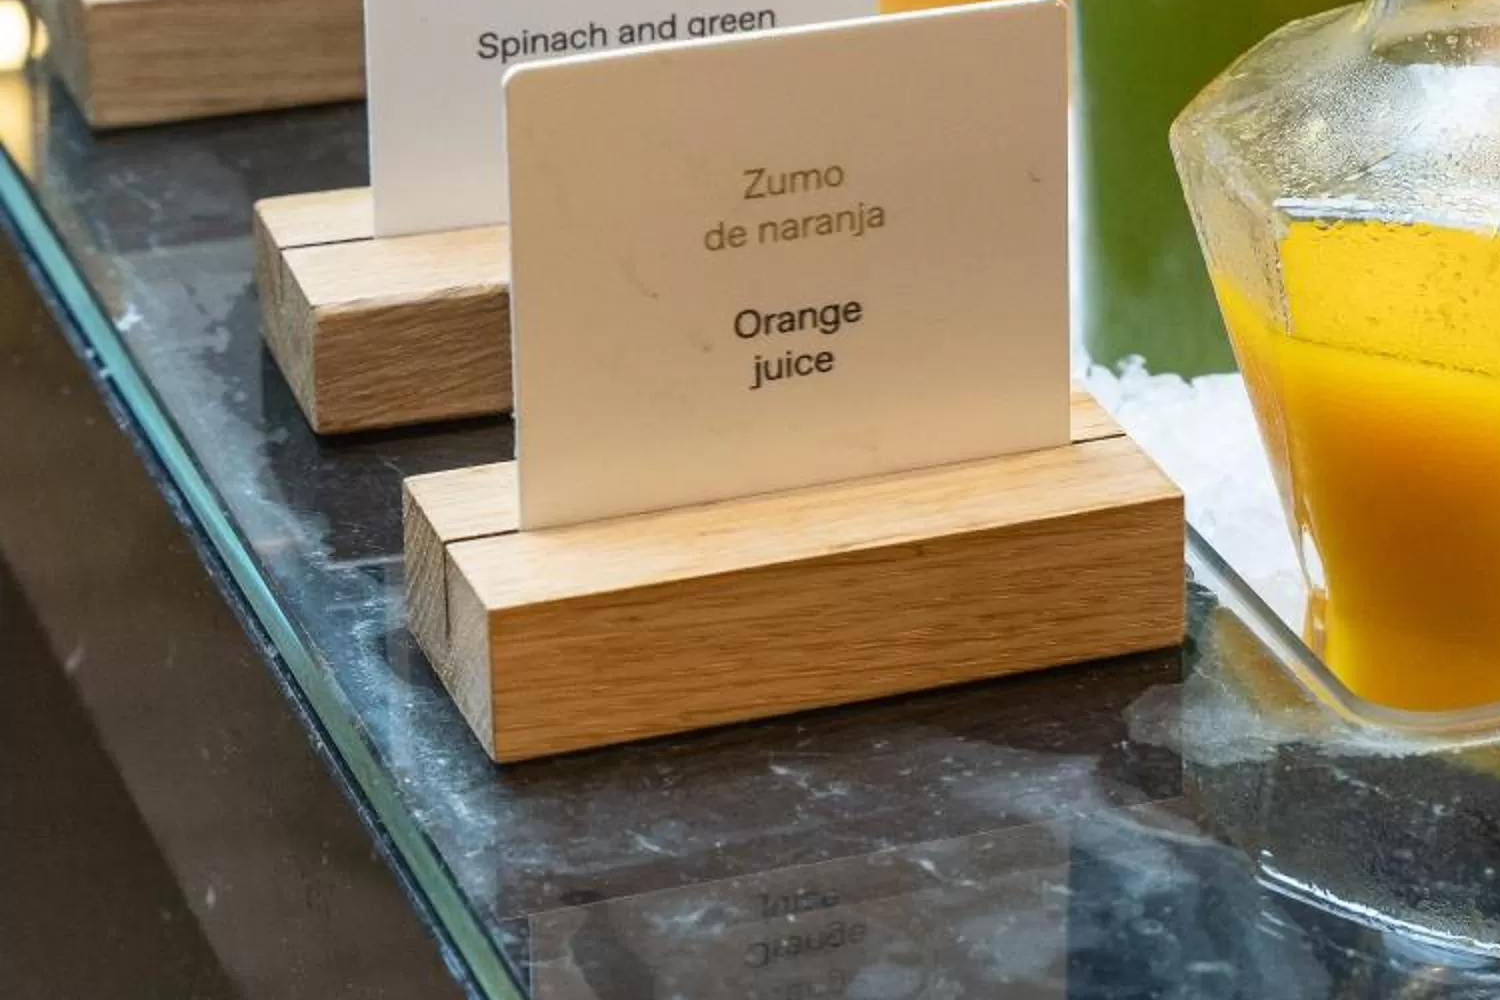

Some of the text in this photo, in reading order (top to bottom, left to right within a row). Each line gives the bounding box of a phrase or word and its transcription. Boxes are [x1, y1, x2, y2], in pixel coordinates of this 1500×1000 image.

[477, 8, 777, 64] Spinach and green
[743, 164, 845, 200] Zumo
[703, 201, 886, 251] de naranja
[733, 300, 863, 340] Orange
[749, 350, 835, 390] juice
